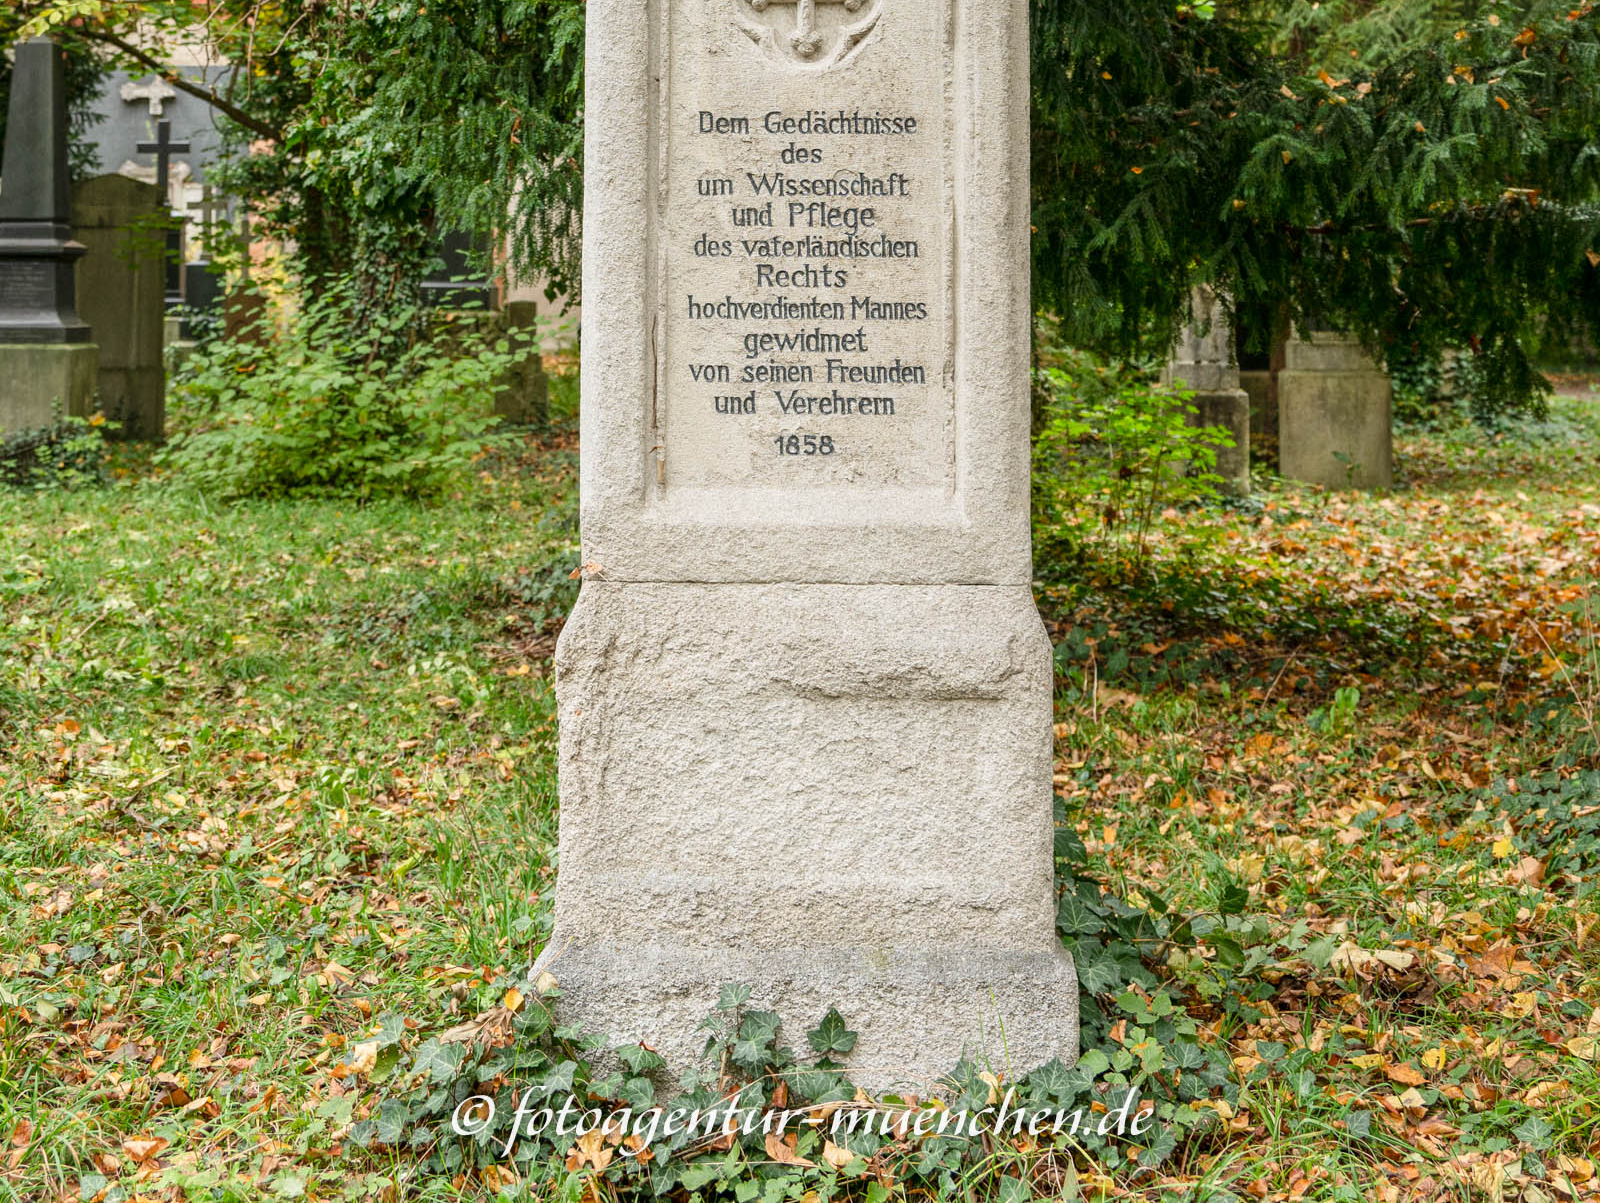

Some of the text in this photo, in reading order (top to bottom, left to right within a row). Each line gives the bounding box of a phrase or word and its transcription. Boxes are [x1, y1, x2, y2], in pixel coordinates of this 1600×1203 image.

[699, 111, 918, 134] Dem Gedächtnisse
[781, 142, 823, 164] des
[697, 173, 909, 197] um Wissenschaft
[732, 202, 876, 235] und Pflege
[694, 233, 920, 258] des vaterländischen
[756, 264, 848, 288] Rechts
[687, 295, 928, 320] hochverdienten Mannes
[743, 326, 869, 359] gewidmet
[689, 359, 926, 384] von seinen Freunden
[714, 390, 896, 415] und Verehrern
[774, 434, 835, 456] 1858
